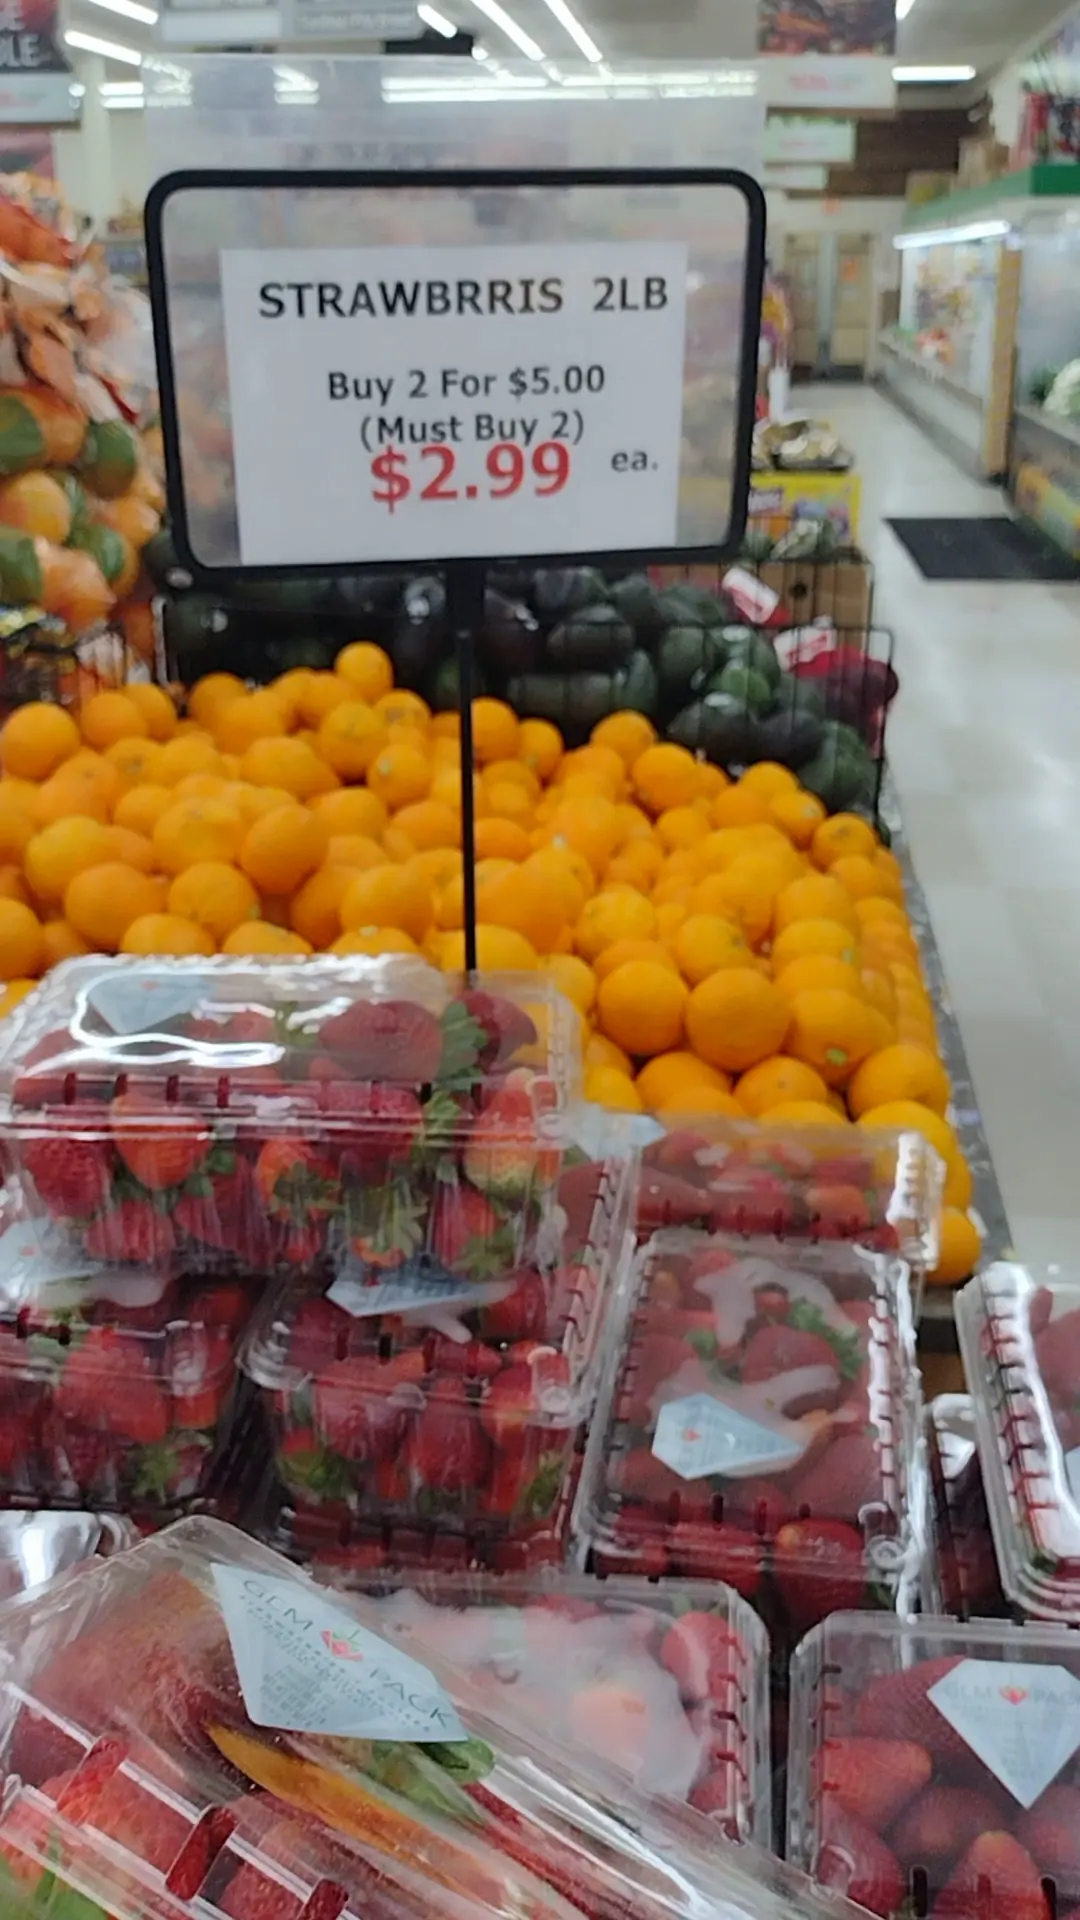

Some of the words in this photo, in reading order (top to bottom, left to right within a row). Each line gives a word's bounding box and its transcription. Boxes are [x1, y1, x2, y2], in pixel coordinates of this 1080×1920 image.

[258, 277, 564, 319] STRAWBRRIS
[593, 276, 669, 312] 2LB
[327, 370, 394, 407] Buy
[408, 369, 428, 399] 2
[440, 368, 498, 398] For
[508, 363, 606, 401] $5.00
[359, 414, 463, 452] (Must
[474, 412, 538, 446] Buy
[549, 409, 585, 446] 2)
[370, 440, 572, 514] $2.99
[610, 450, 659, 473] ea.
[243, 1579, 314, 1631] GEM
[369, 1668, 453, 1728] PACK
